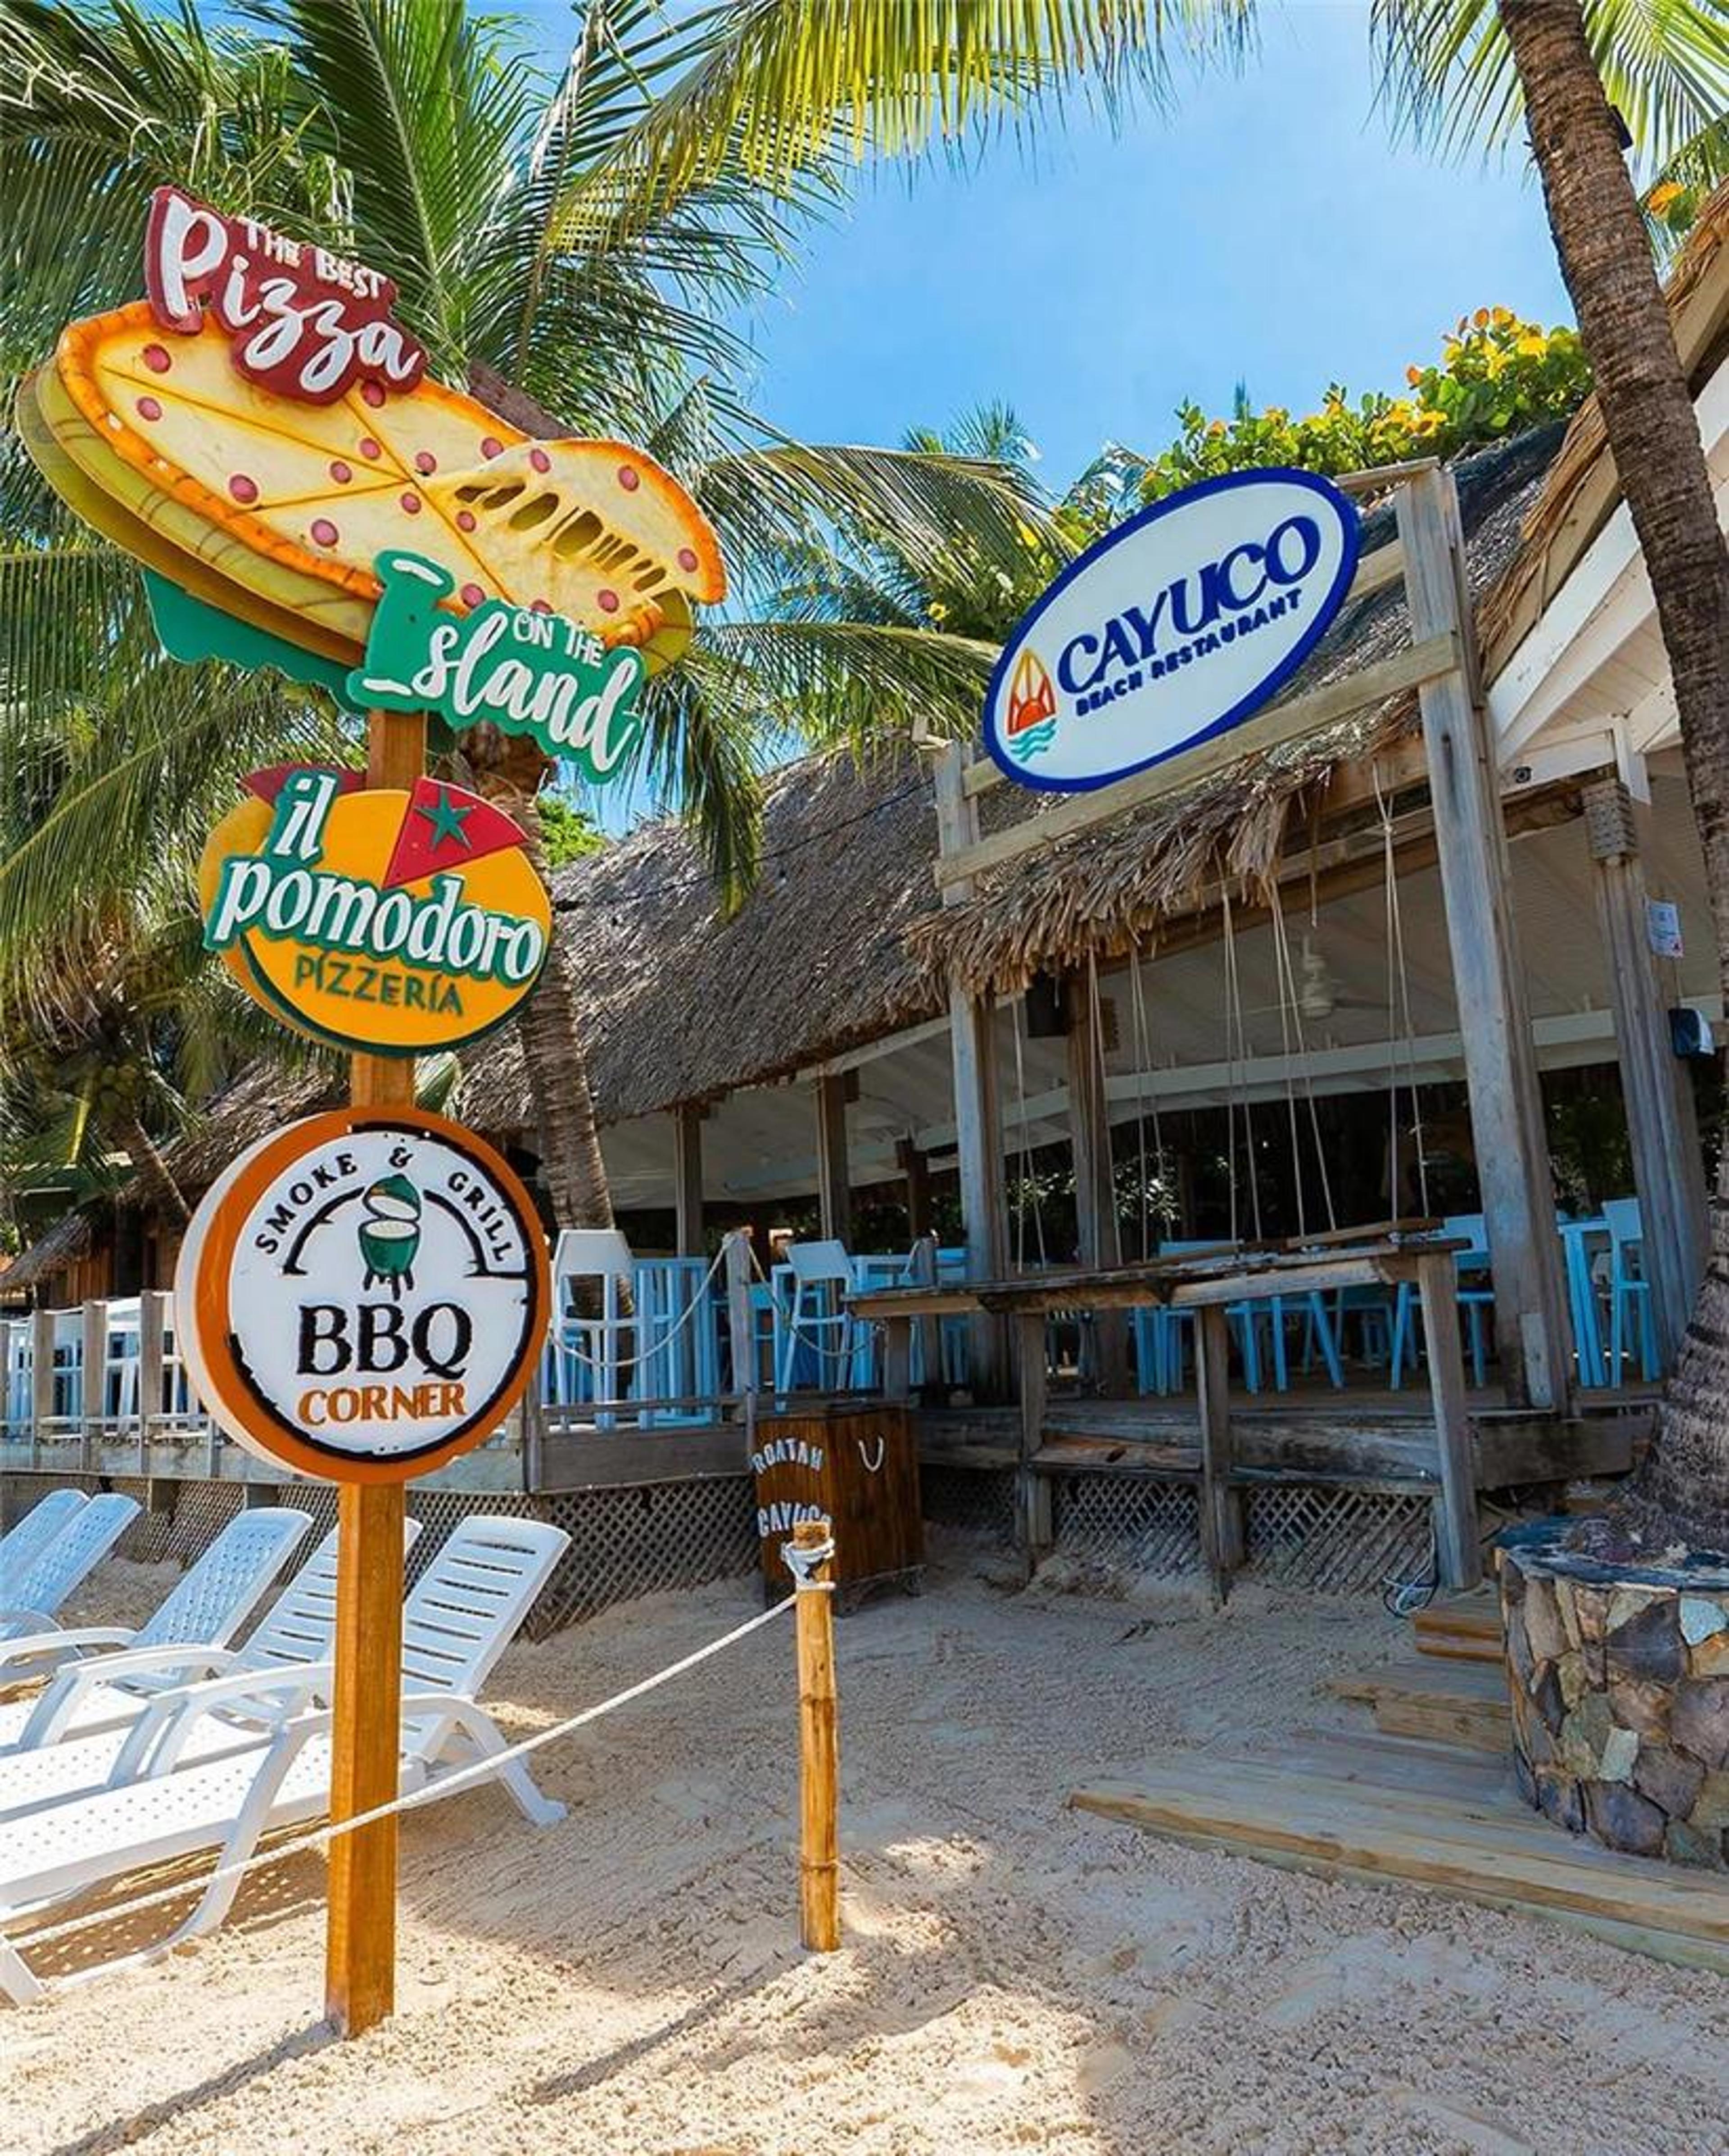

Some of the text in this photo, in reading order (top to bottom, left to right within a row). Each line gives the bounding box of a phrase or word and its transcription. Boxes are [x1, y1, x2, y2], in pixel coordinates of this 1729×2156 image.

[159, 193, 421, 393] Pizza
[235, 215, 388, 299] THE BEST
[513, 612, 606, 668] ON THE
[1057, 515, 1321, 695] CAYUCO
[1076, 588, 1303, 717] BEACH RESTAURANT
[274, 773, 337, 861] il
[213, 859, 543, 980] pomodoro
[255, 1146, 513, 1261] SMOKE & GRILL
[296, 1302, 473, 1380] BBQ
[297, 1382, 466, 1426] CORNER
